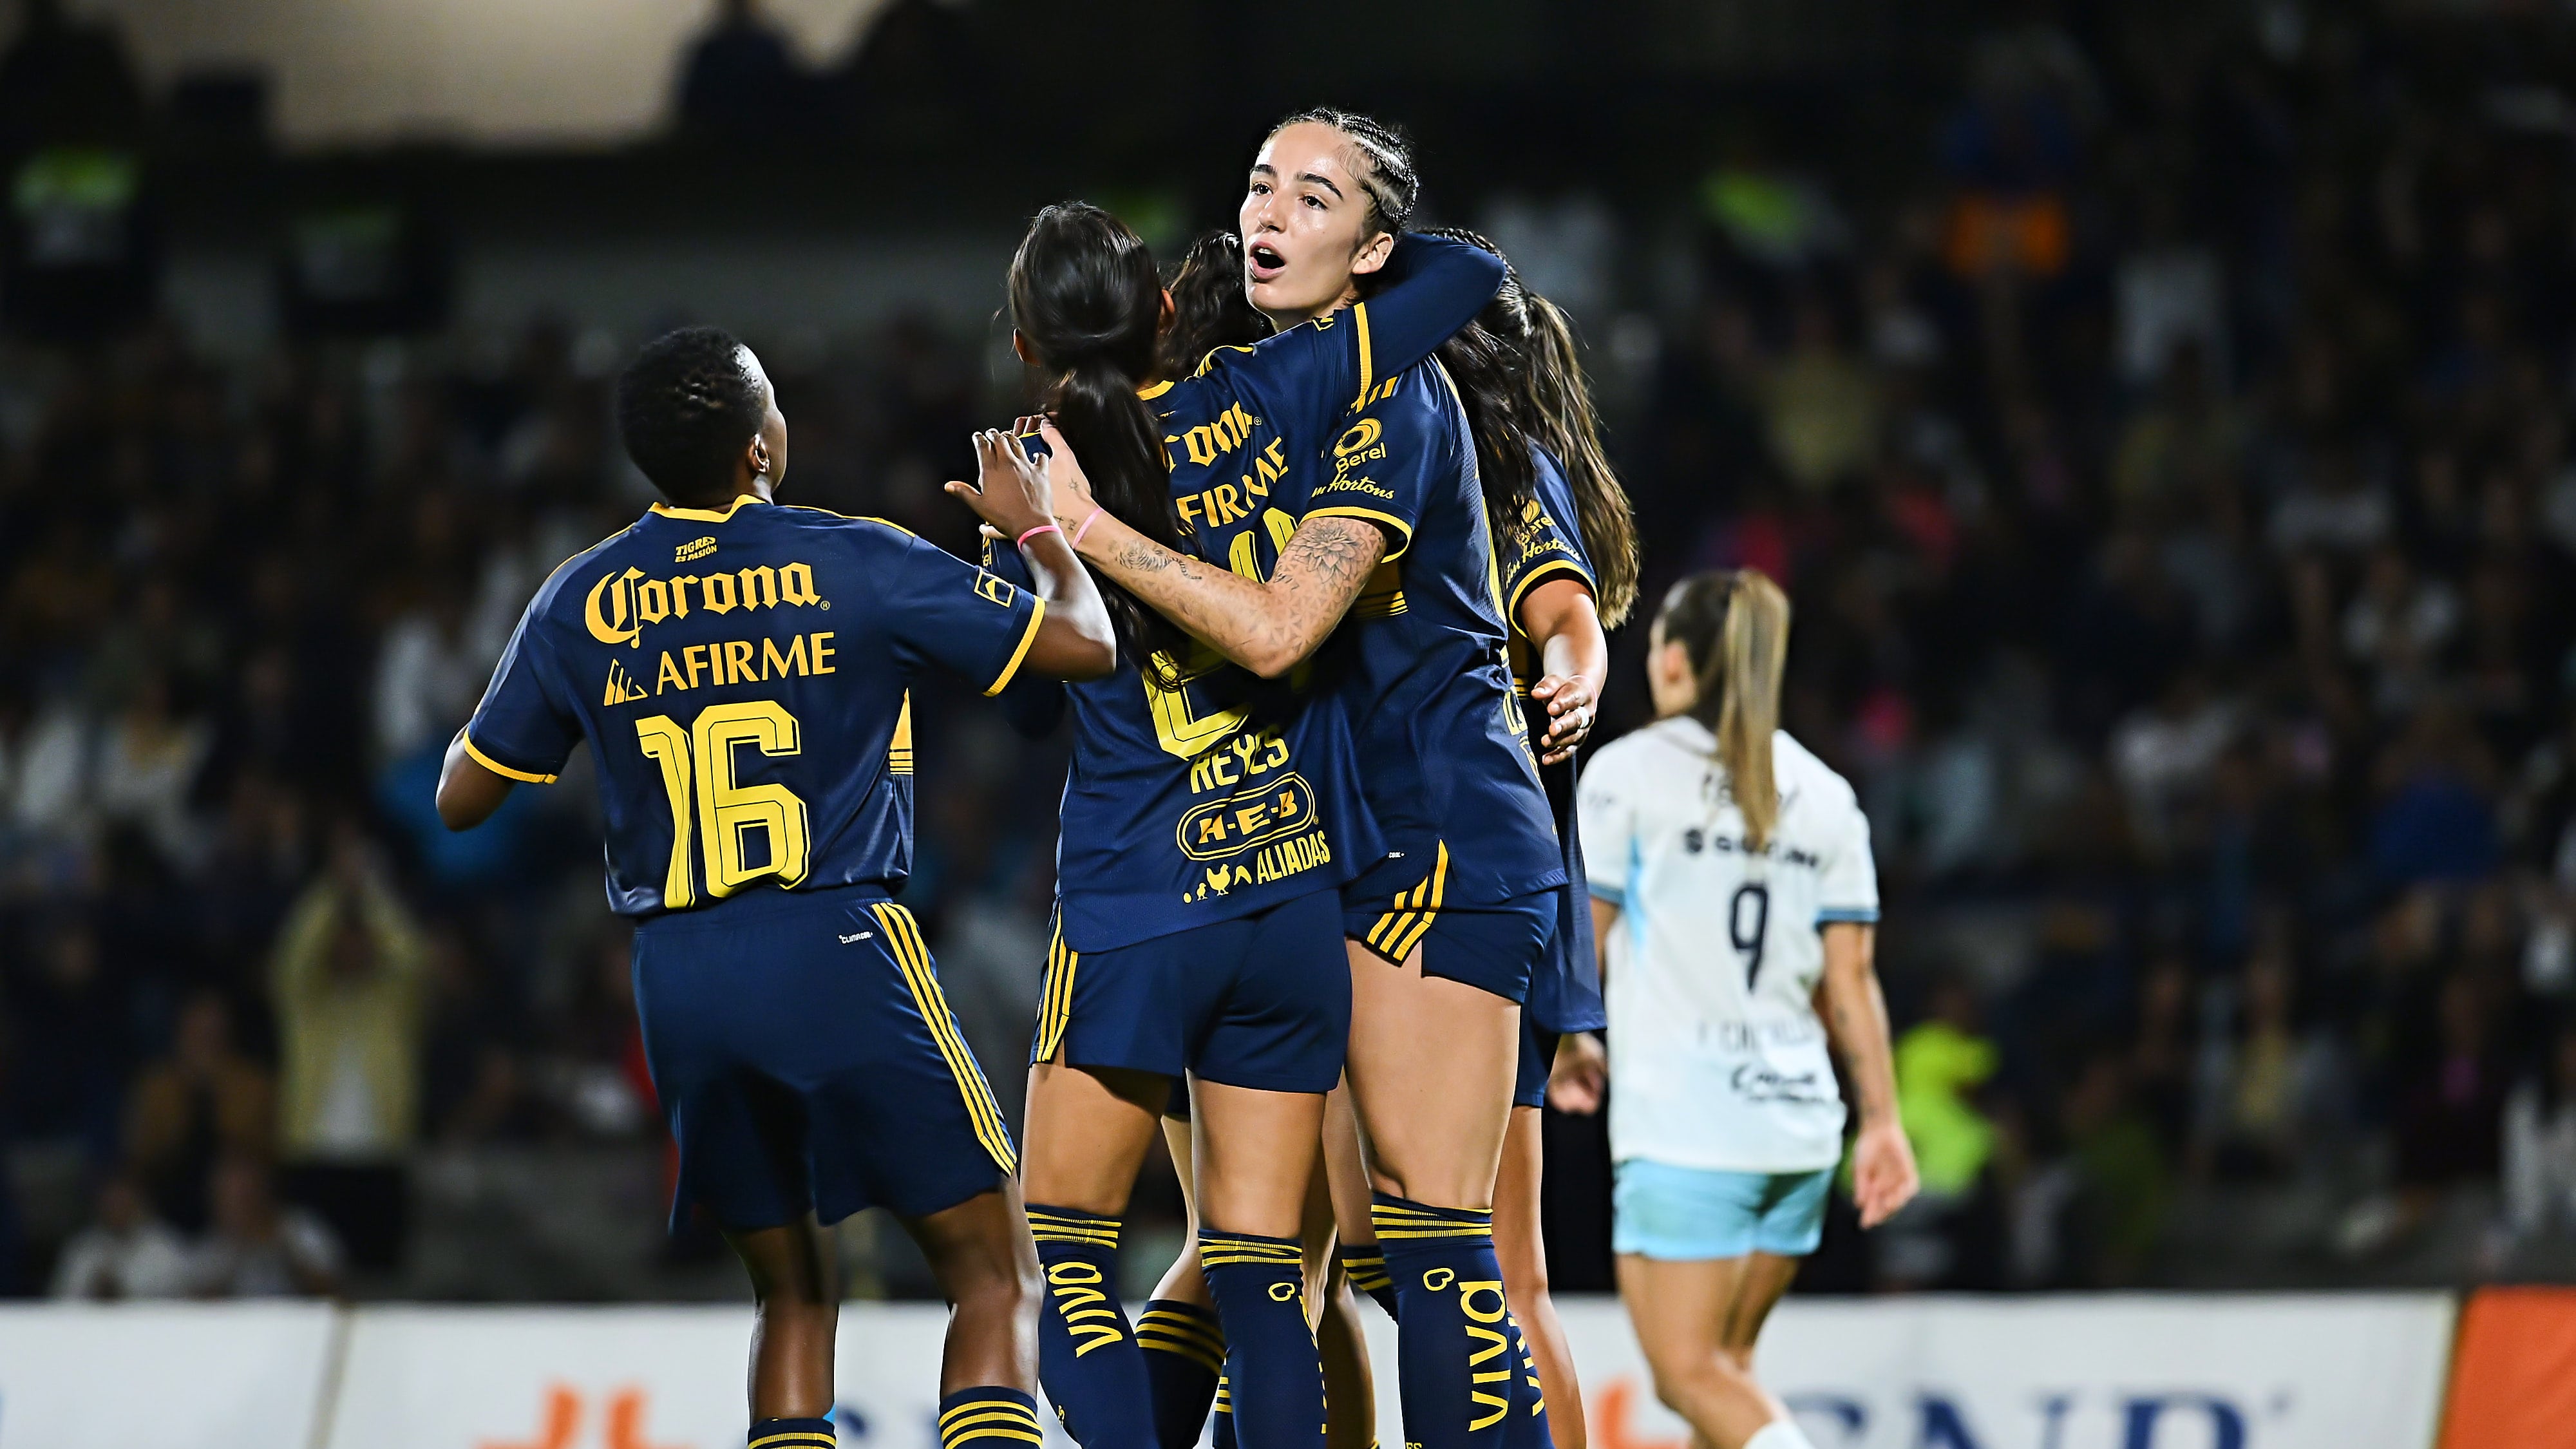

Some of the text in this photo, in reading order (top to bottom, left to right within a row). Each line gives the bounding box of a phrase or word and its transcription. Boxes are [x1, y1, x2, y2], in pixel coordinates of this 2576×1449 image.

[1176, 436, 1289, 528] FIRME
[1327, 473, 1394, 499] Hortons
[1336, 442, 1386, 473] Berel
[676, 536, 716, 556] TIGRES
[585, 562, 821, 649] Corona
[656, 632, 836, 696] AFIRME
[635, 700, 811, 909] 16
[1258, 830, 1331, 885] ALIADAS
[1729, 880, 1770, 994] 9
[1458, 1280, 1511, 1432] viva
